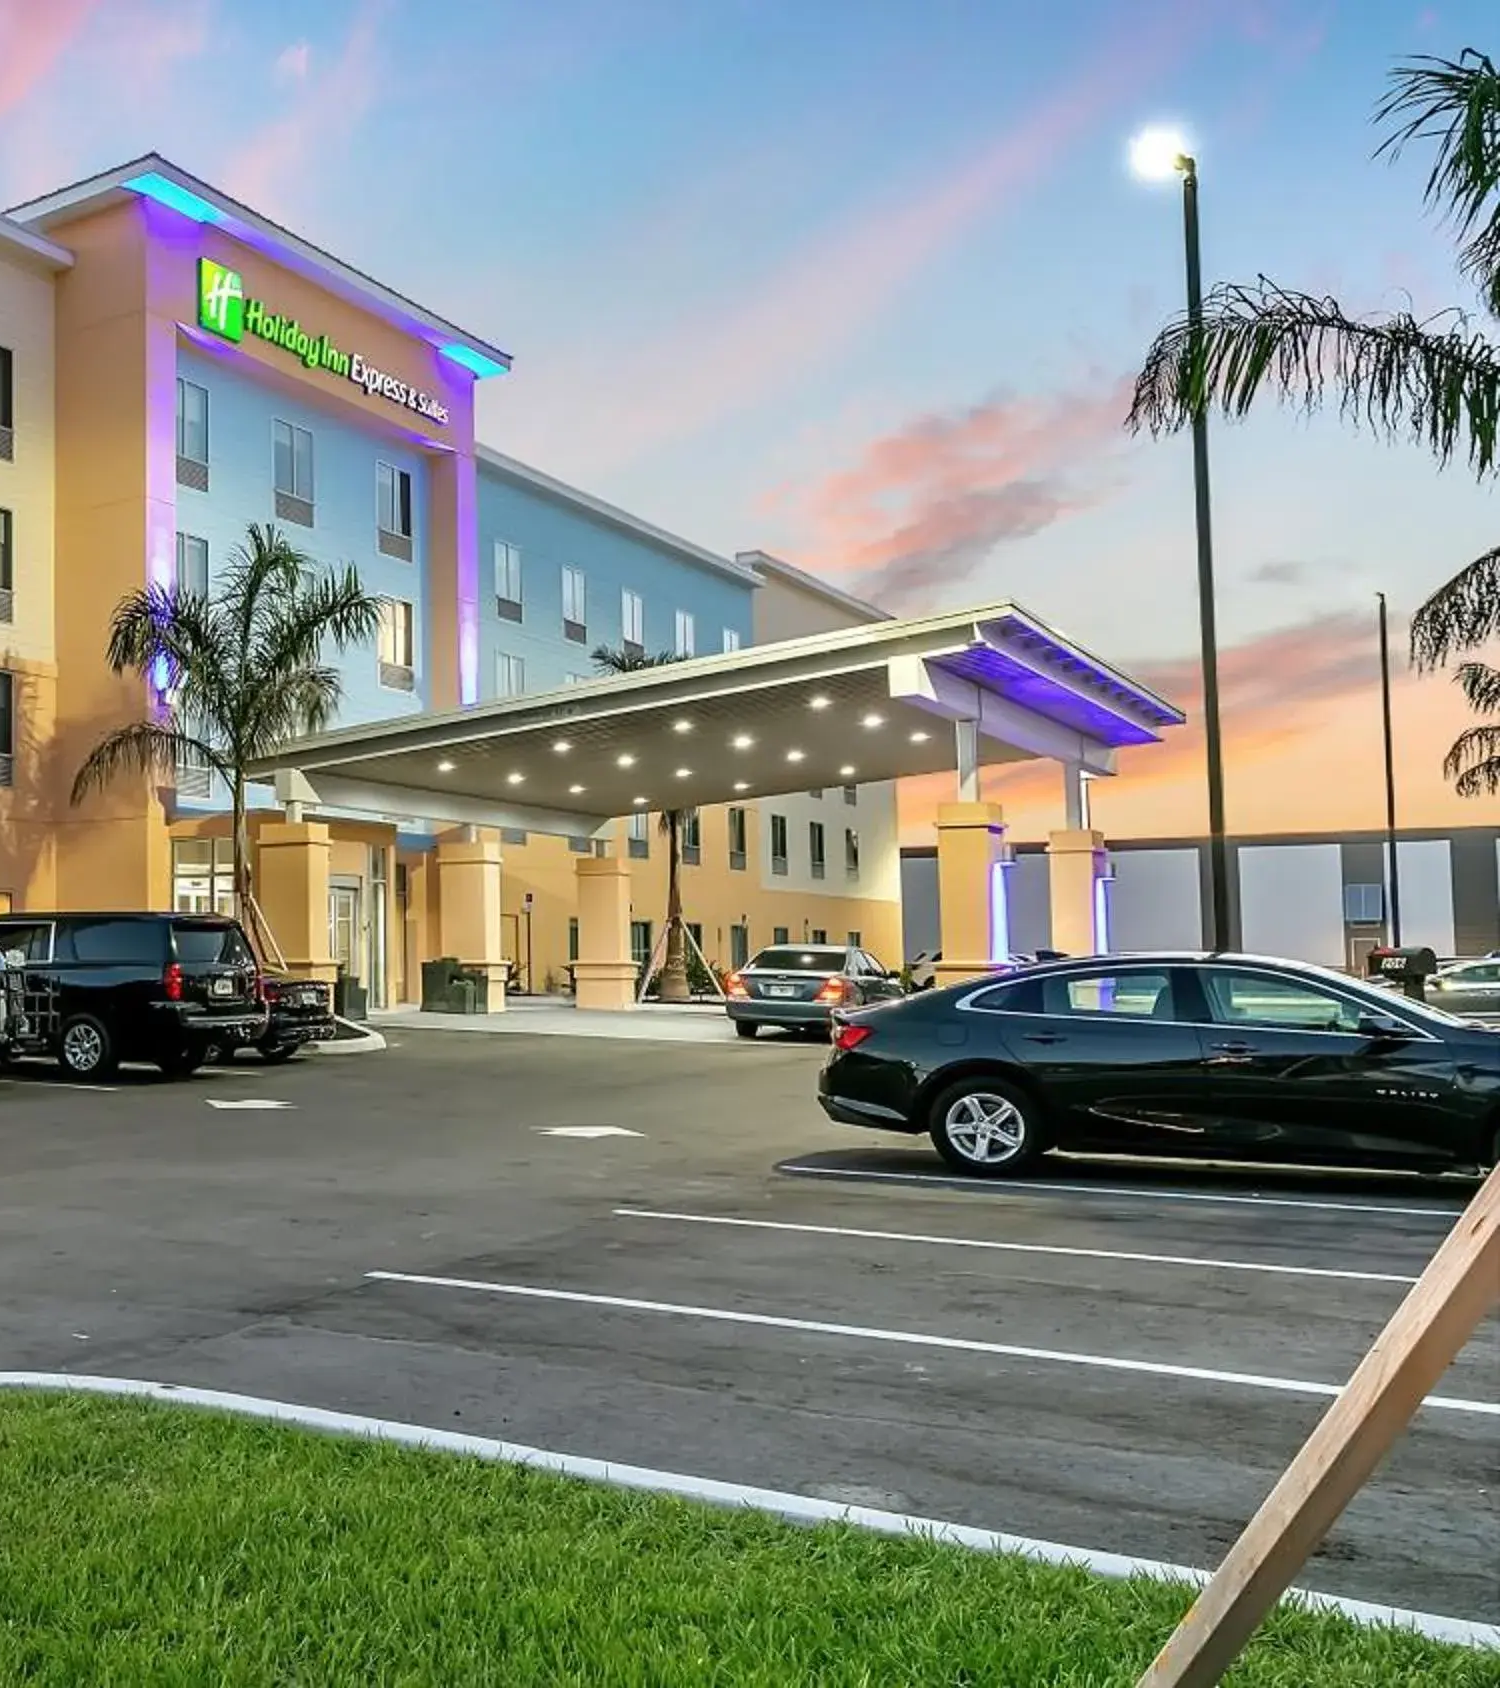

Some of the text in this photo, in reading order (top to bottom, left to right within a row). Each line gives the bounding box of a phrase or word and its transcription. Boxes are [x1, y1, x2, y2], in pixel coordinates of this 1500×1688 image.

[246, 299, 449, 422] Holiday Inn Express & Suites
